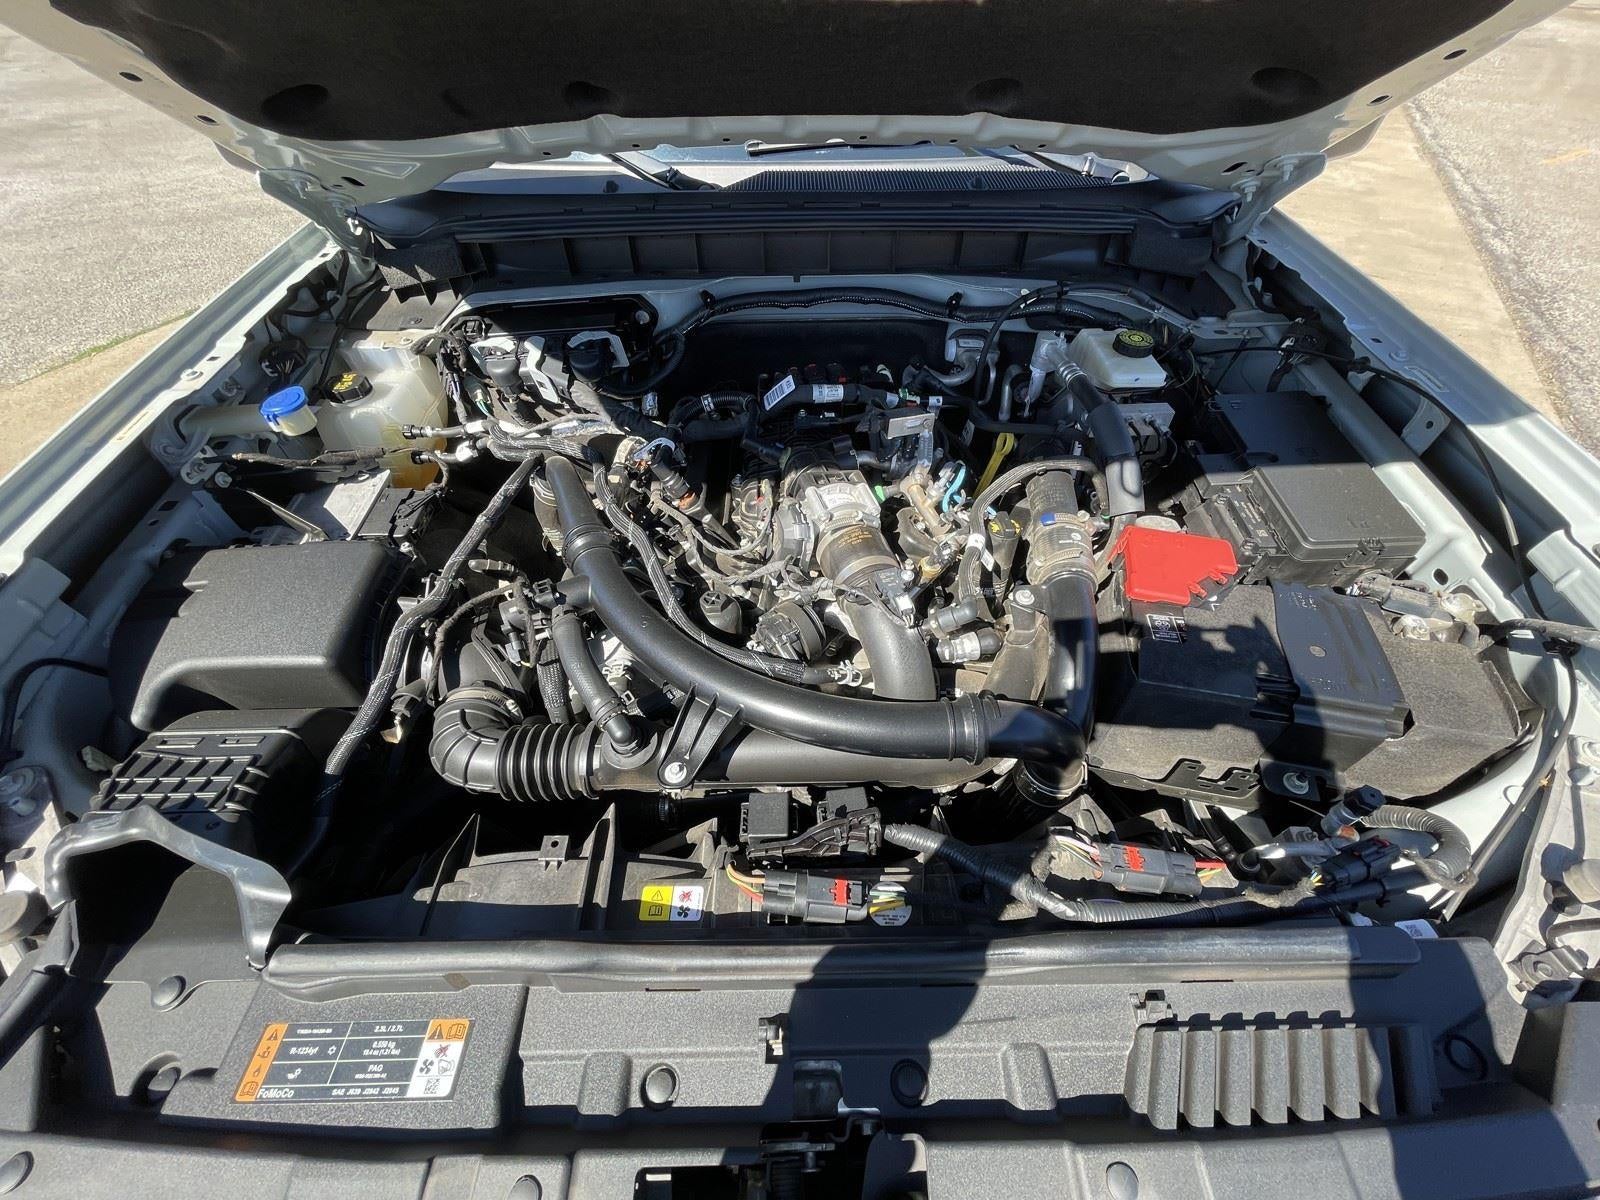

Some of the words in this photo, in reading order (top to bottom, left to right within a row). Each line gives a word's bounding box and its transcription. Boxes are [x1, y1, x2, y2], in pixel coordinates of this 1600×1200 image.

[289, 1046, 319, 1056] R-1234yf
[367, 1064, 384, 1072] PAG
[257, 1088, 295, 1099] FoMoCo
[331, 1088, 346, 1096] SAE
